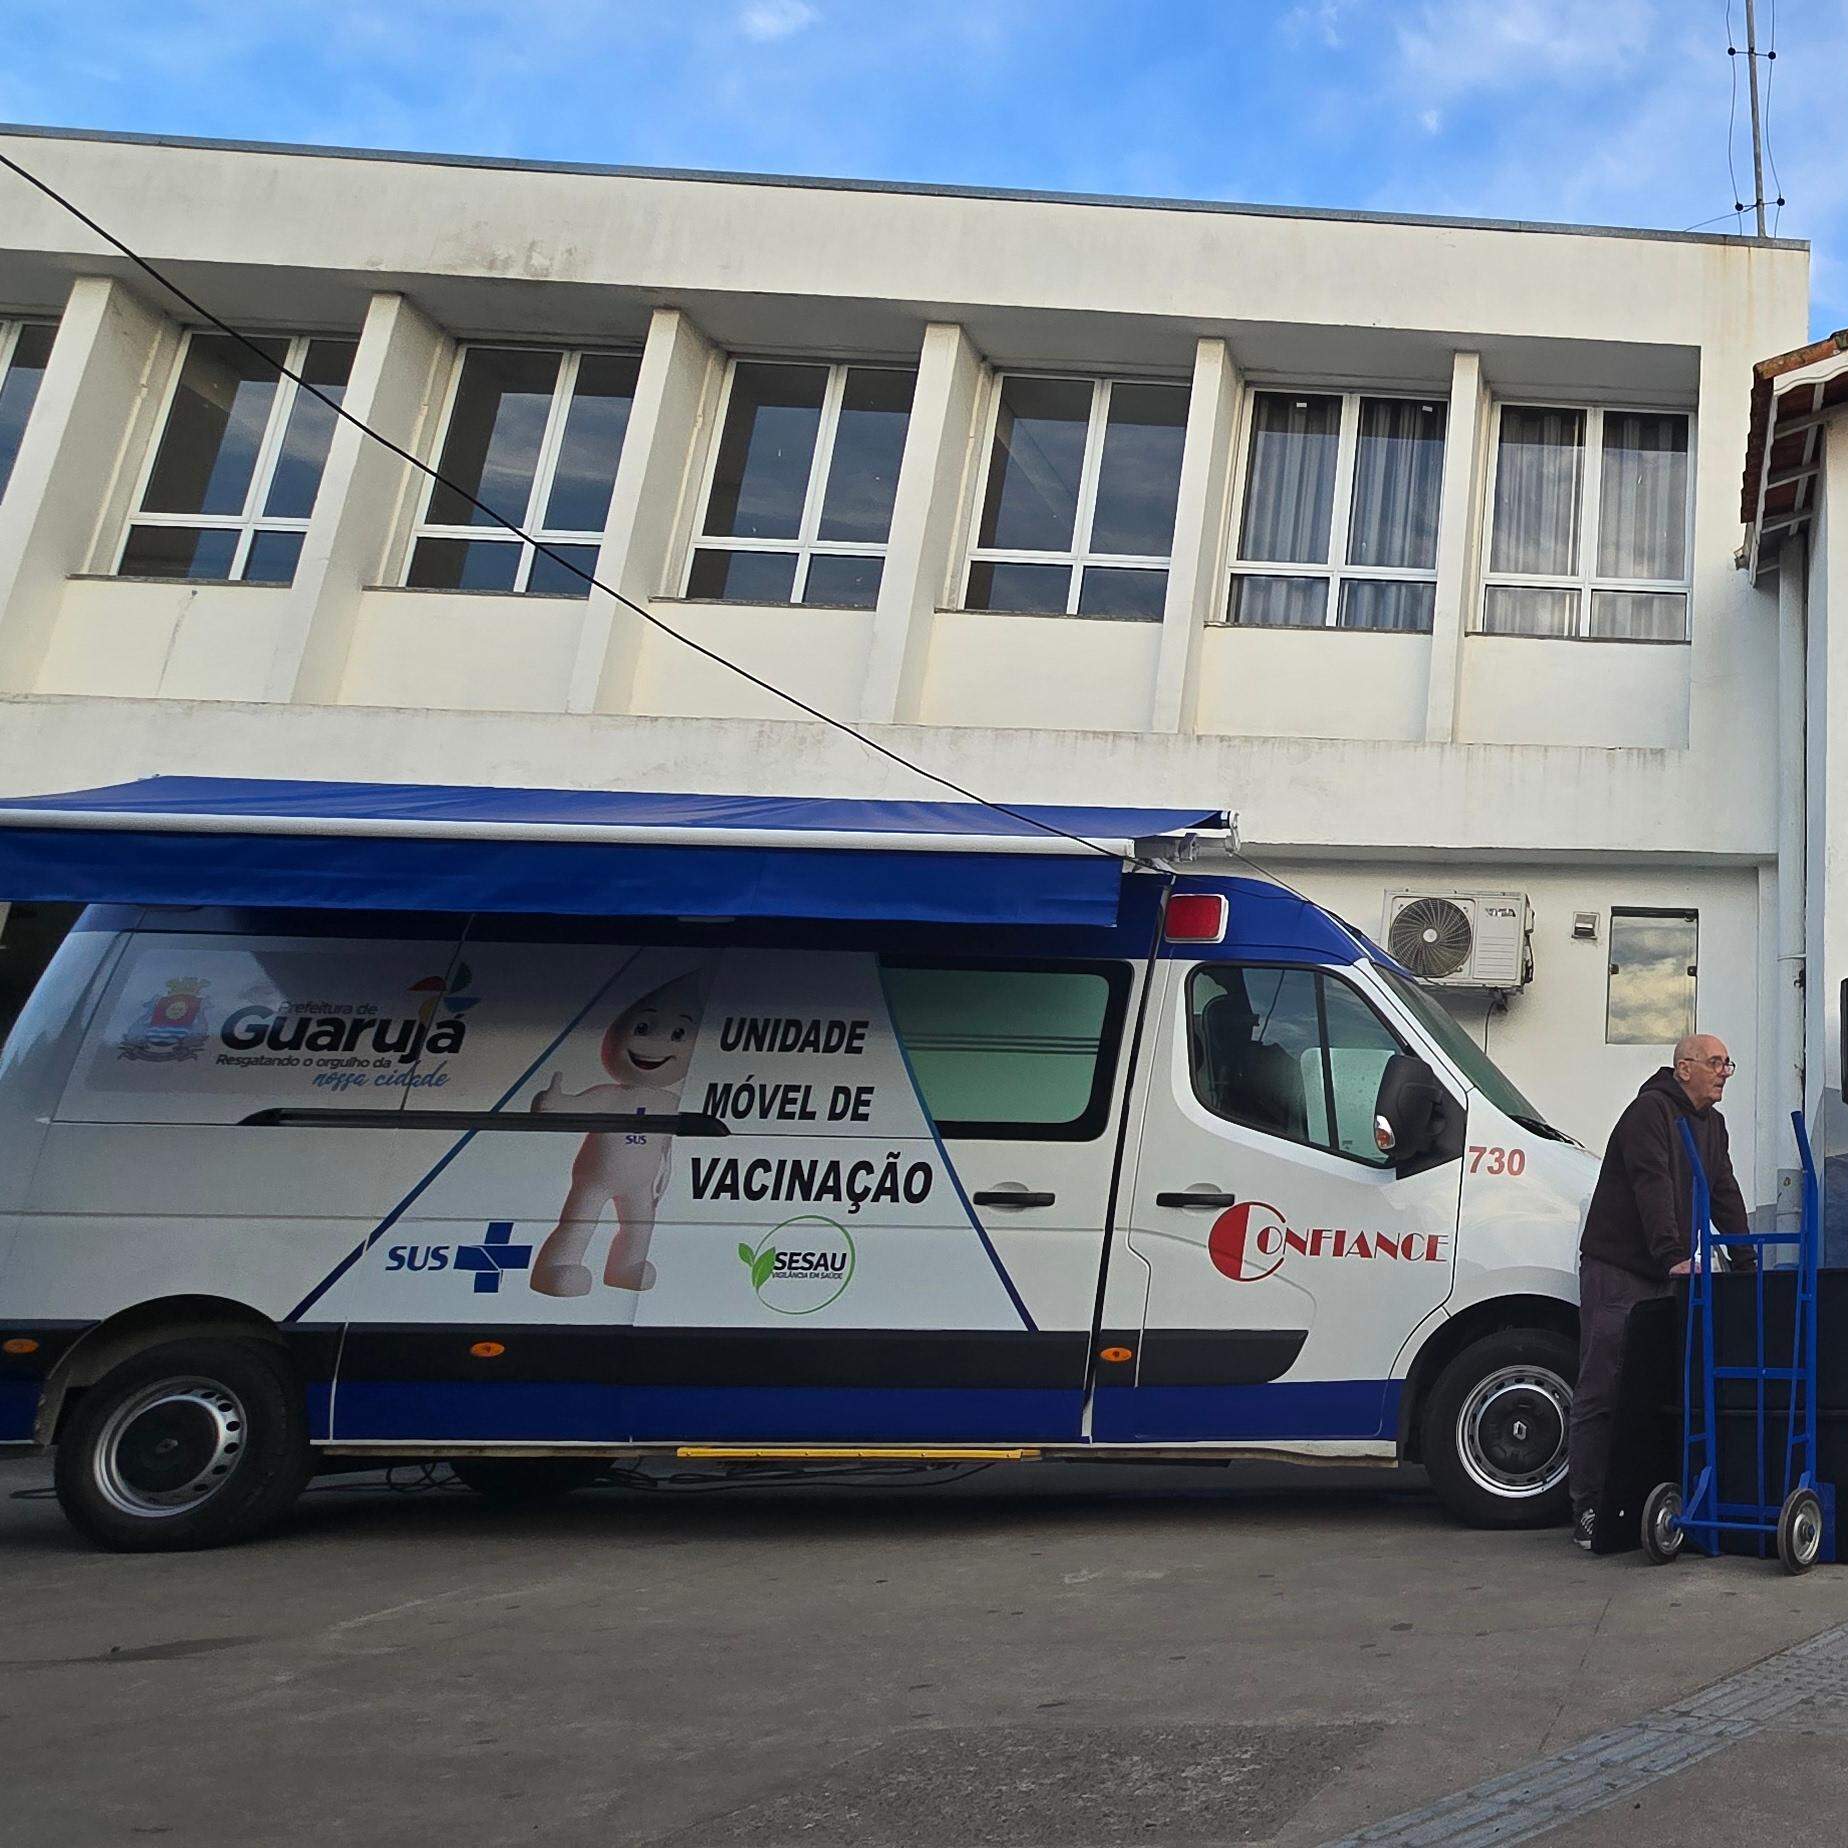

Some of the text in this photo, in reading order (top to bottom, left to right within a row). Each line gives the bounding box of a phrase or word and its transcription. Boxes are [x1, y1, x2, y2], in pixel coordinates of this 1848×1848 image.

[278, 1001, 379, 1015] Prefeitura de
[220, 1004, 467, 1064] Guarujá
[719, 1017, 870, 1055] UNIDADE
[215, 1054, 393, 1069] Resgatando o orgulho da
[702, 1074, 876, 1122] MÓVEL DE
[625, 1135, 648, 1145] SUS
[1468, 1145, 1526, 1177] 730
[691, 1151, 934, 1215] VACINAÇÃO
[1207, 1200, 1450, 1282] CONFIANCE
[384, 1245, 451, 1272] SUS
[772, 1251, 847, 1272] SESAU
